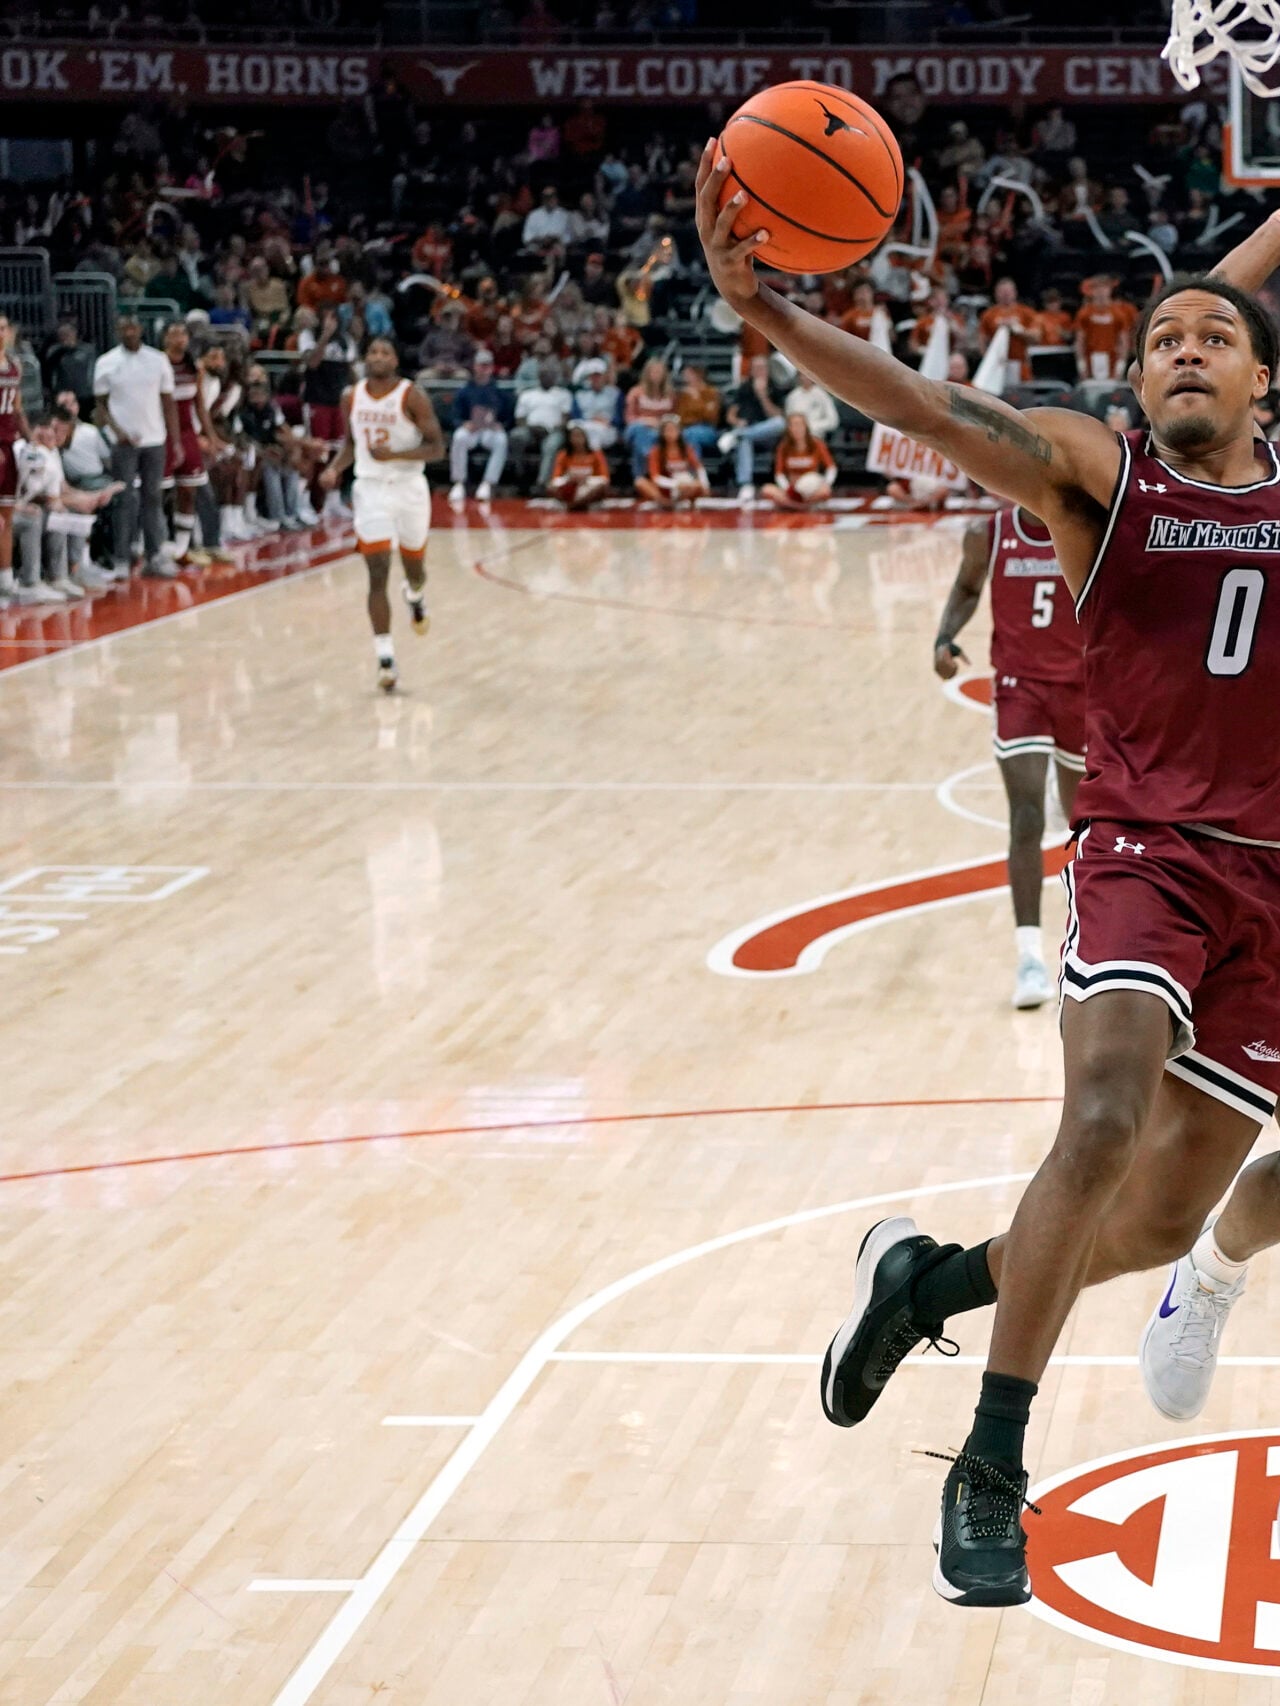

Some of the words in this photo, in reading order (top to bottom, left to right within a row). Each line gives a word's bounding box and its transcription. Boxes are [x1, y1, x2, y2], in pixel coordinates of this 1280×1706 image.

[204, 54, 370, 95] HORNS
[528, 57, 770, 97] WELCOME
[1152, 518, 1192, 547] NEW
[1193, 522, 1259, 548] MEXICO
[1031, 580, 1057, 629] 5
[1206, 567, 1265, 677] 0
